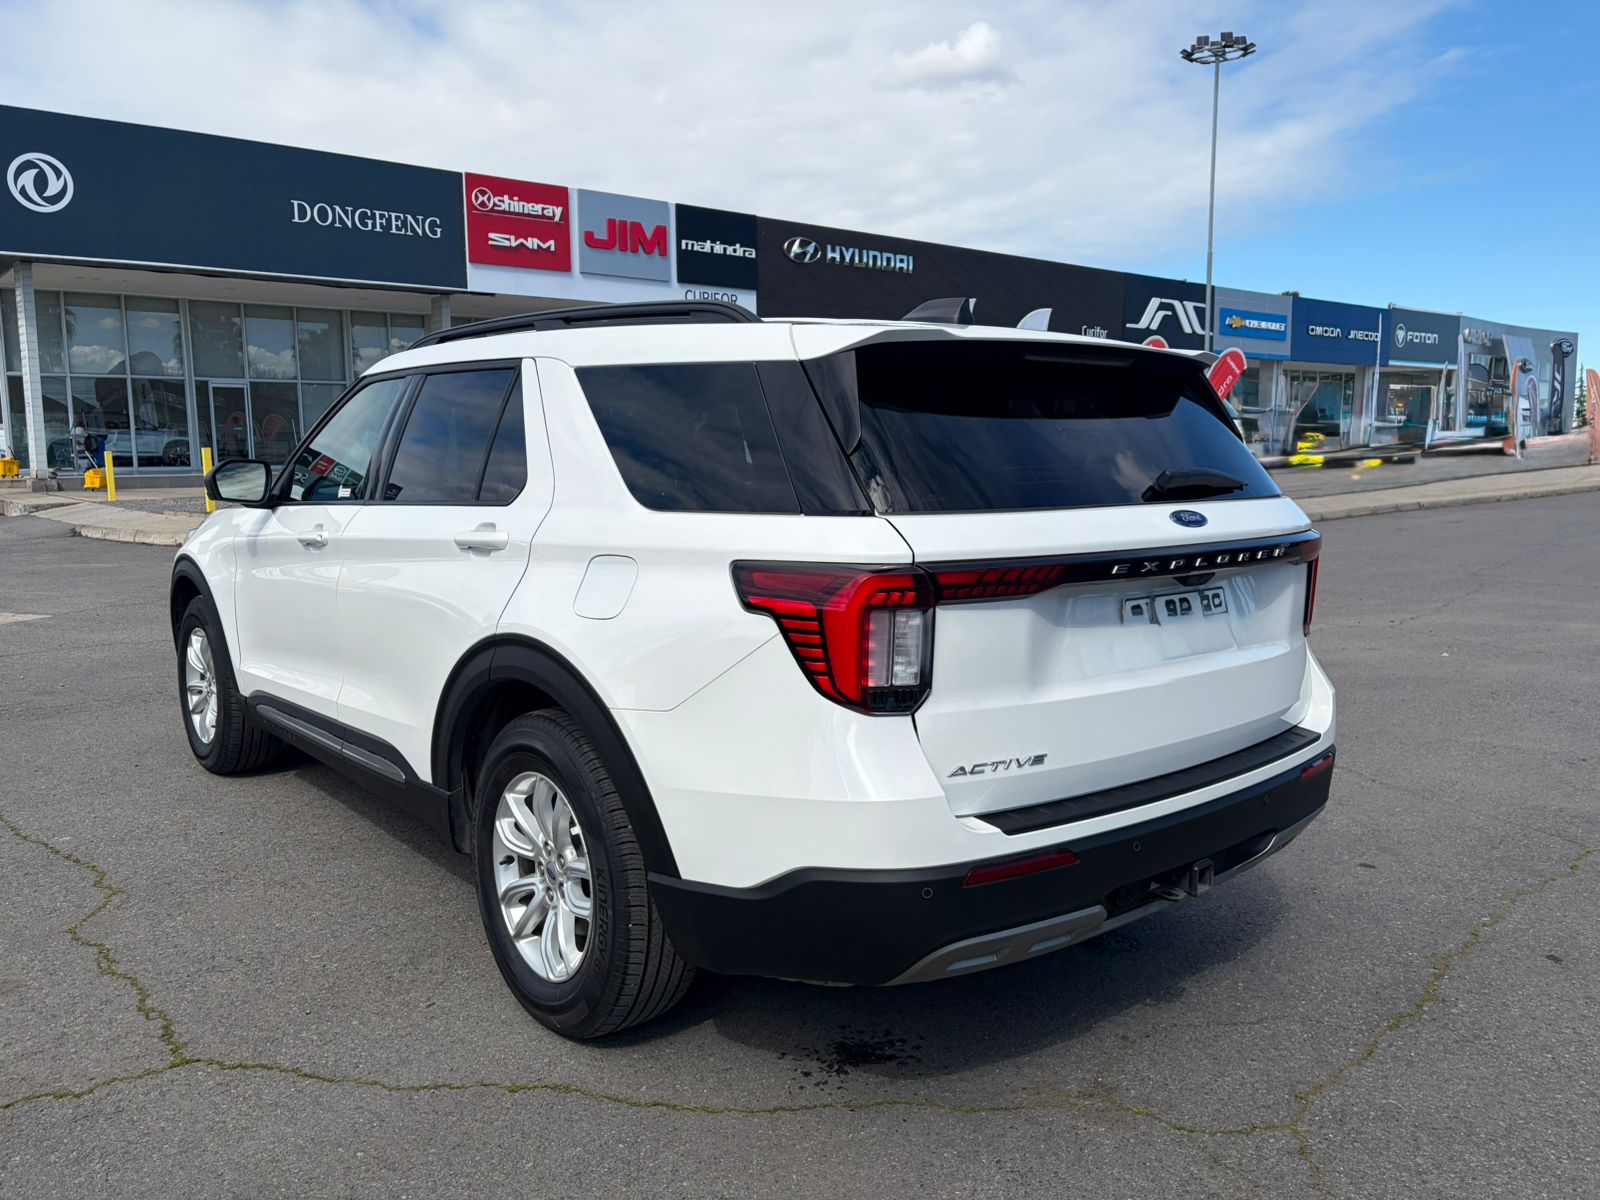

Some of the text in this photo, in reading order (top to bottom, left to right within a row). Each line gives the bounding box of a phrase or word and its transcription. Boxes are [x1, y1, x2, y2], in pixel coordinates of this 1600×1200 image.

[291, 199, 442, 239] DONGFENG
[488, 233, 556, 252] SWM
[584, 218, 668, 257] JIM
[681, 238, 757, 259] mahindra
[825, 243, 914, 273] HYUNDAI
[1308, 325, 1342, 338] OMODA
[1407, 331, 1438, 344] FOTON
[1112, 548, 1287, 575] EXPLORER
[947, 753, 1048, 778] ACTIVE
